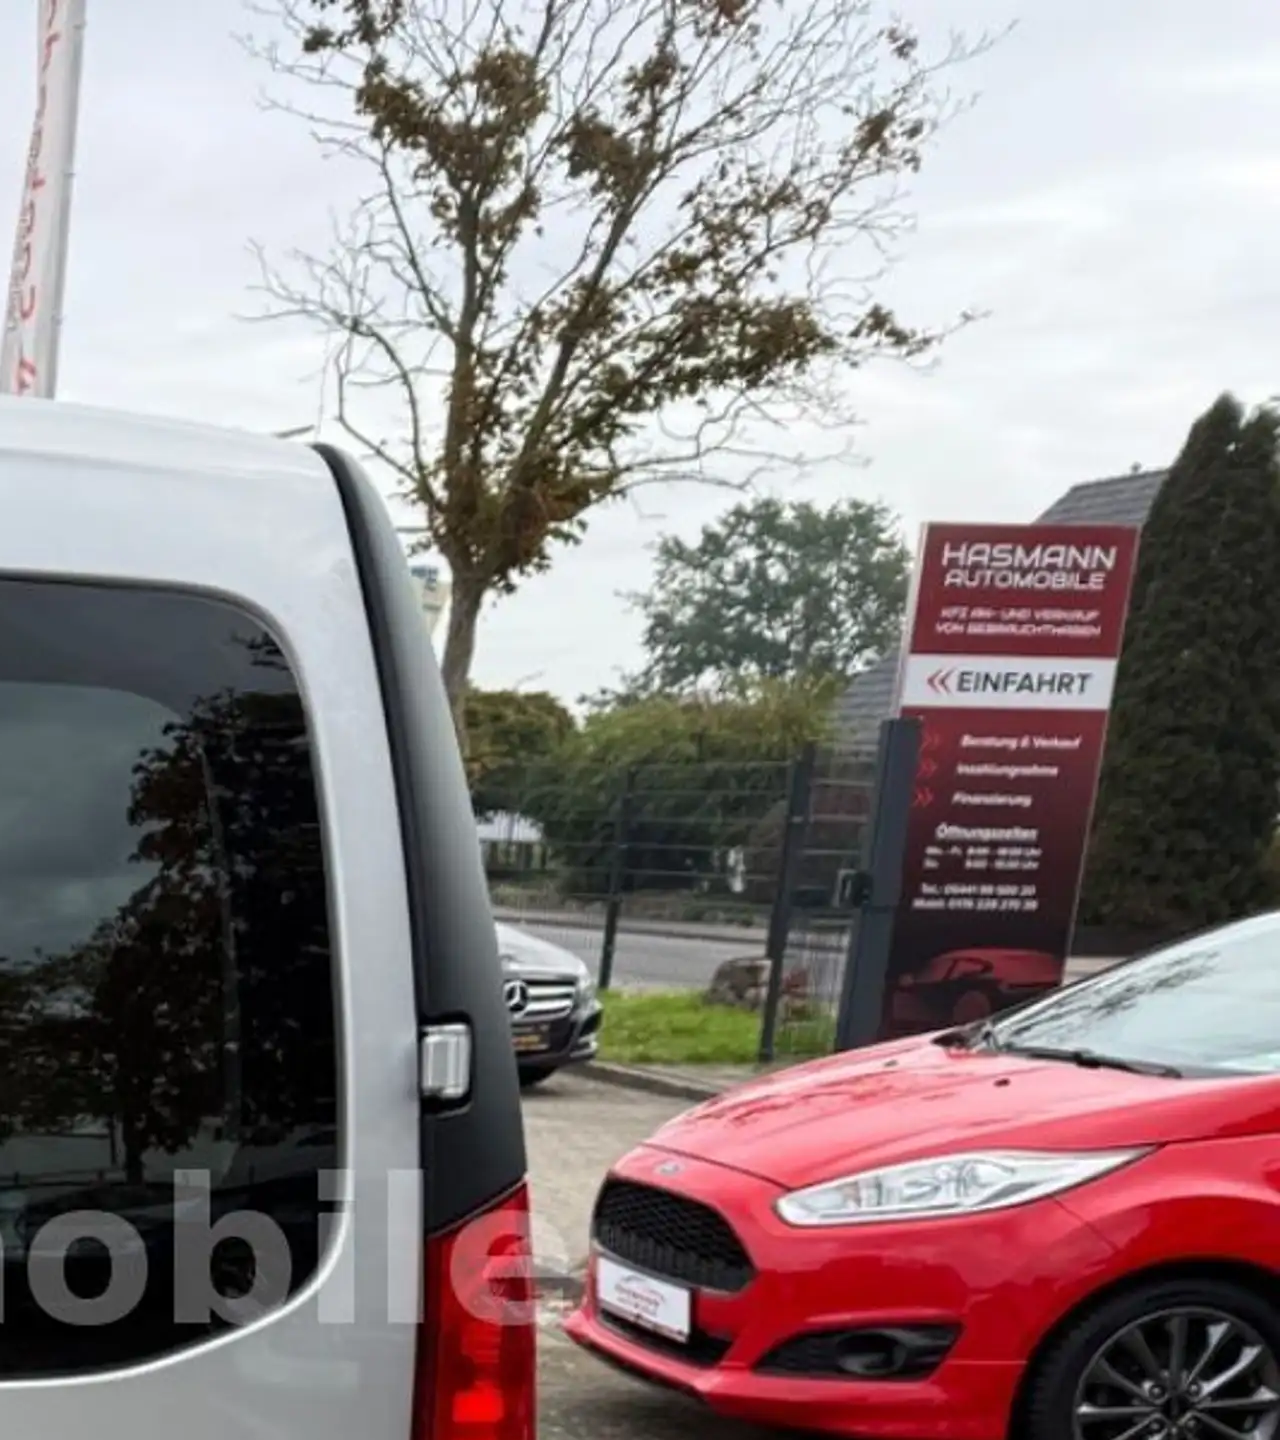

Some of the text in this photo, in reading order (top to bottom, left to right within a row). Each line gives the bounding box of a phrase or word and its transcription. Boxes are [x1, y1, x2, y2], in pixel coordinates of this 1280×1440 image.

[942, 542, 1117, 570] HASMANN
[943, 569, 1106, 590] AUTOMOBILE
[956, 670, 1093, 695] EINFAHRT
